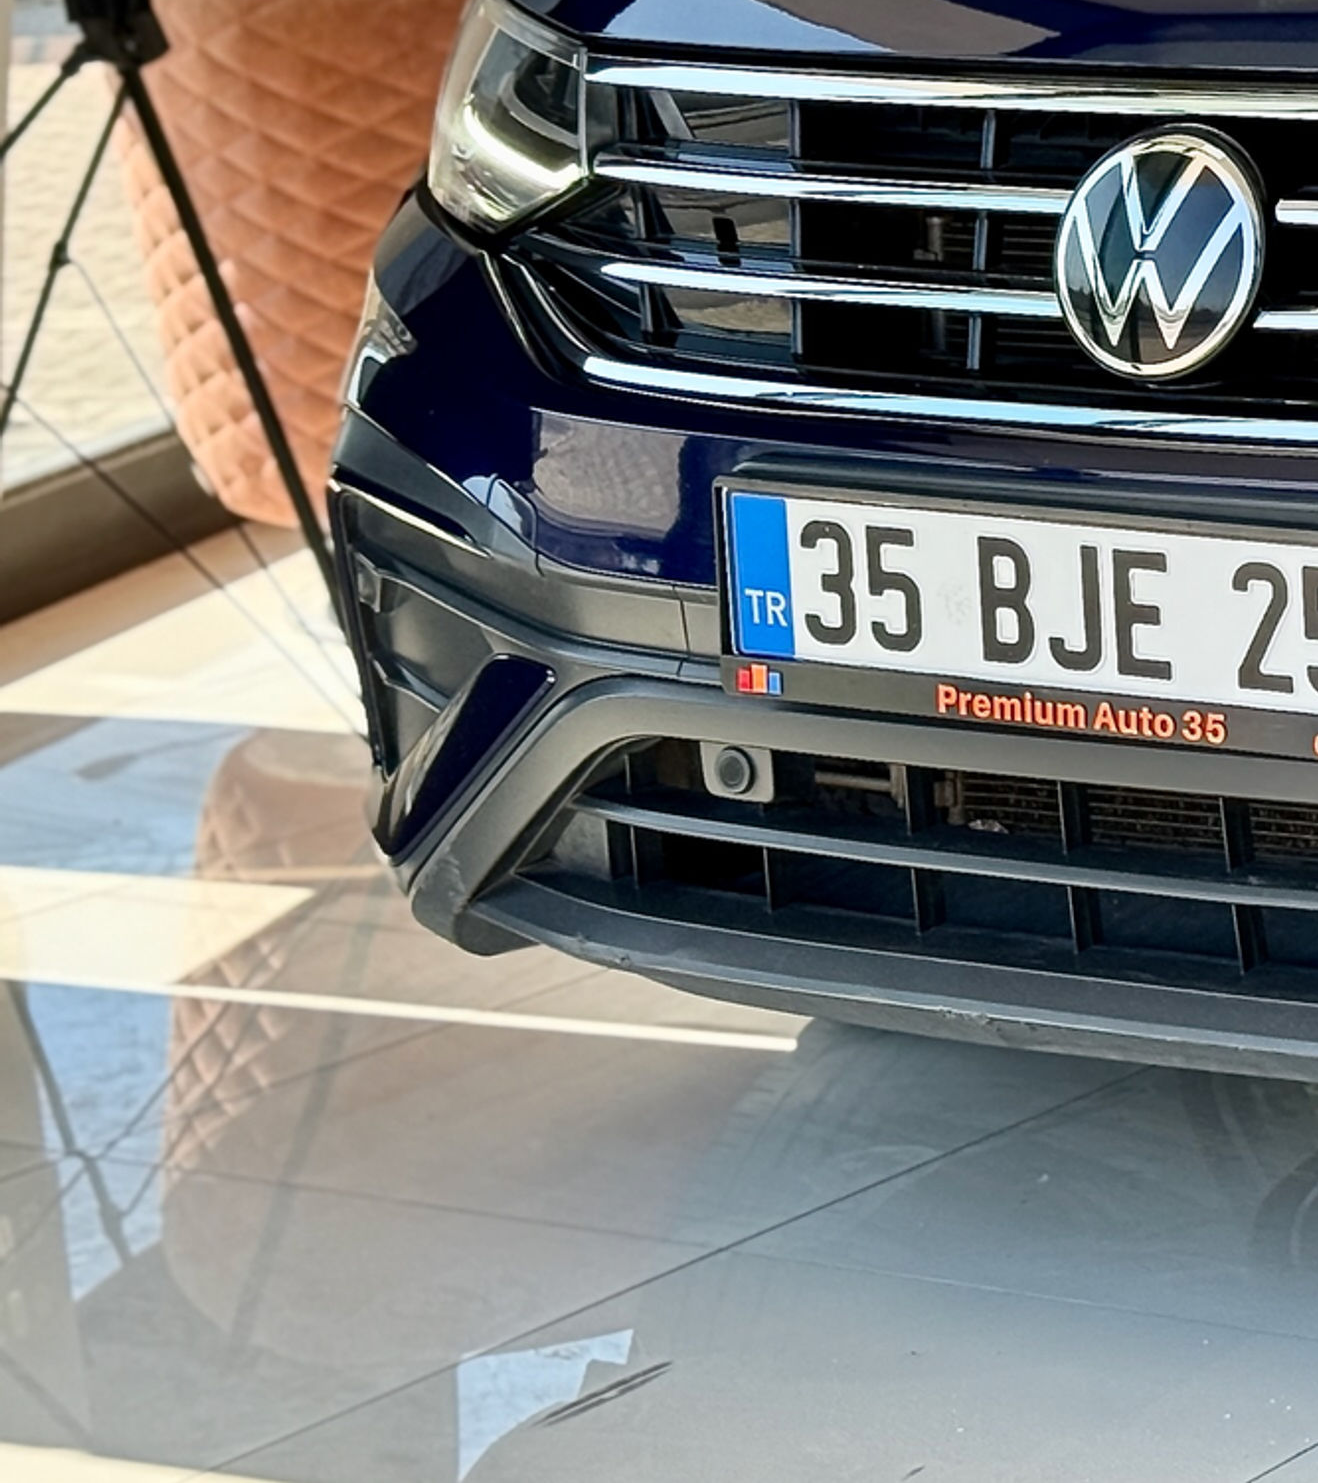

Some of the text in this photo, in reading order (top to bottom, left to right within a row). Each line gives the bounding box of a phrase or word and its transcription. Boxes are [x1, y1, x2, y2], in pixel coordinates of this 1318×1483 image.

[745, 589, 788, 628] TR
[800, 520, 924, 653] 35
[977, 536, 1172, 681] BJE
[936, 683, 1227, 745] Premium Auto 35
